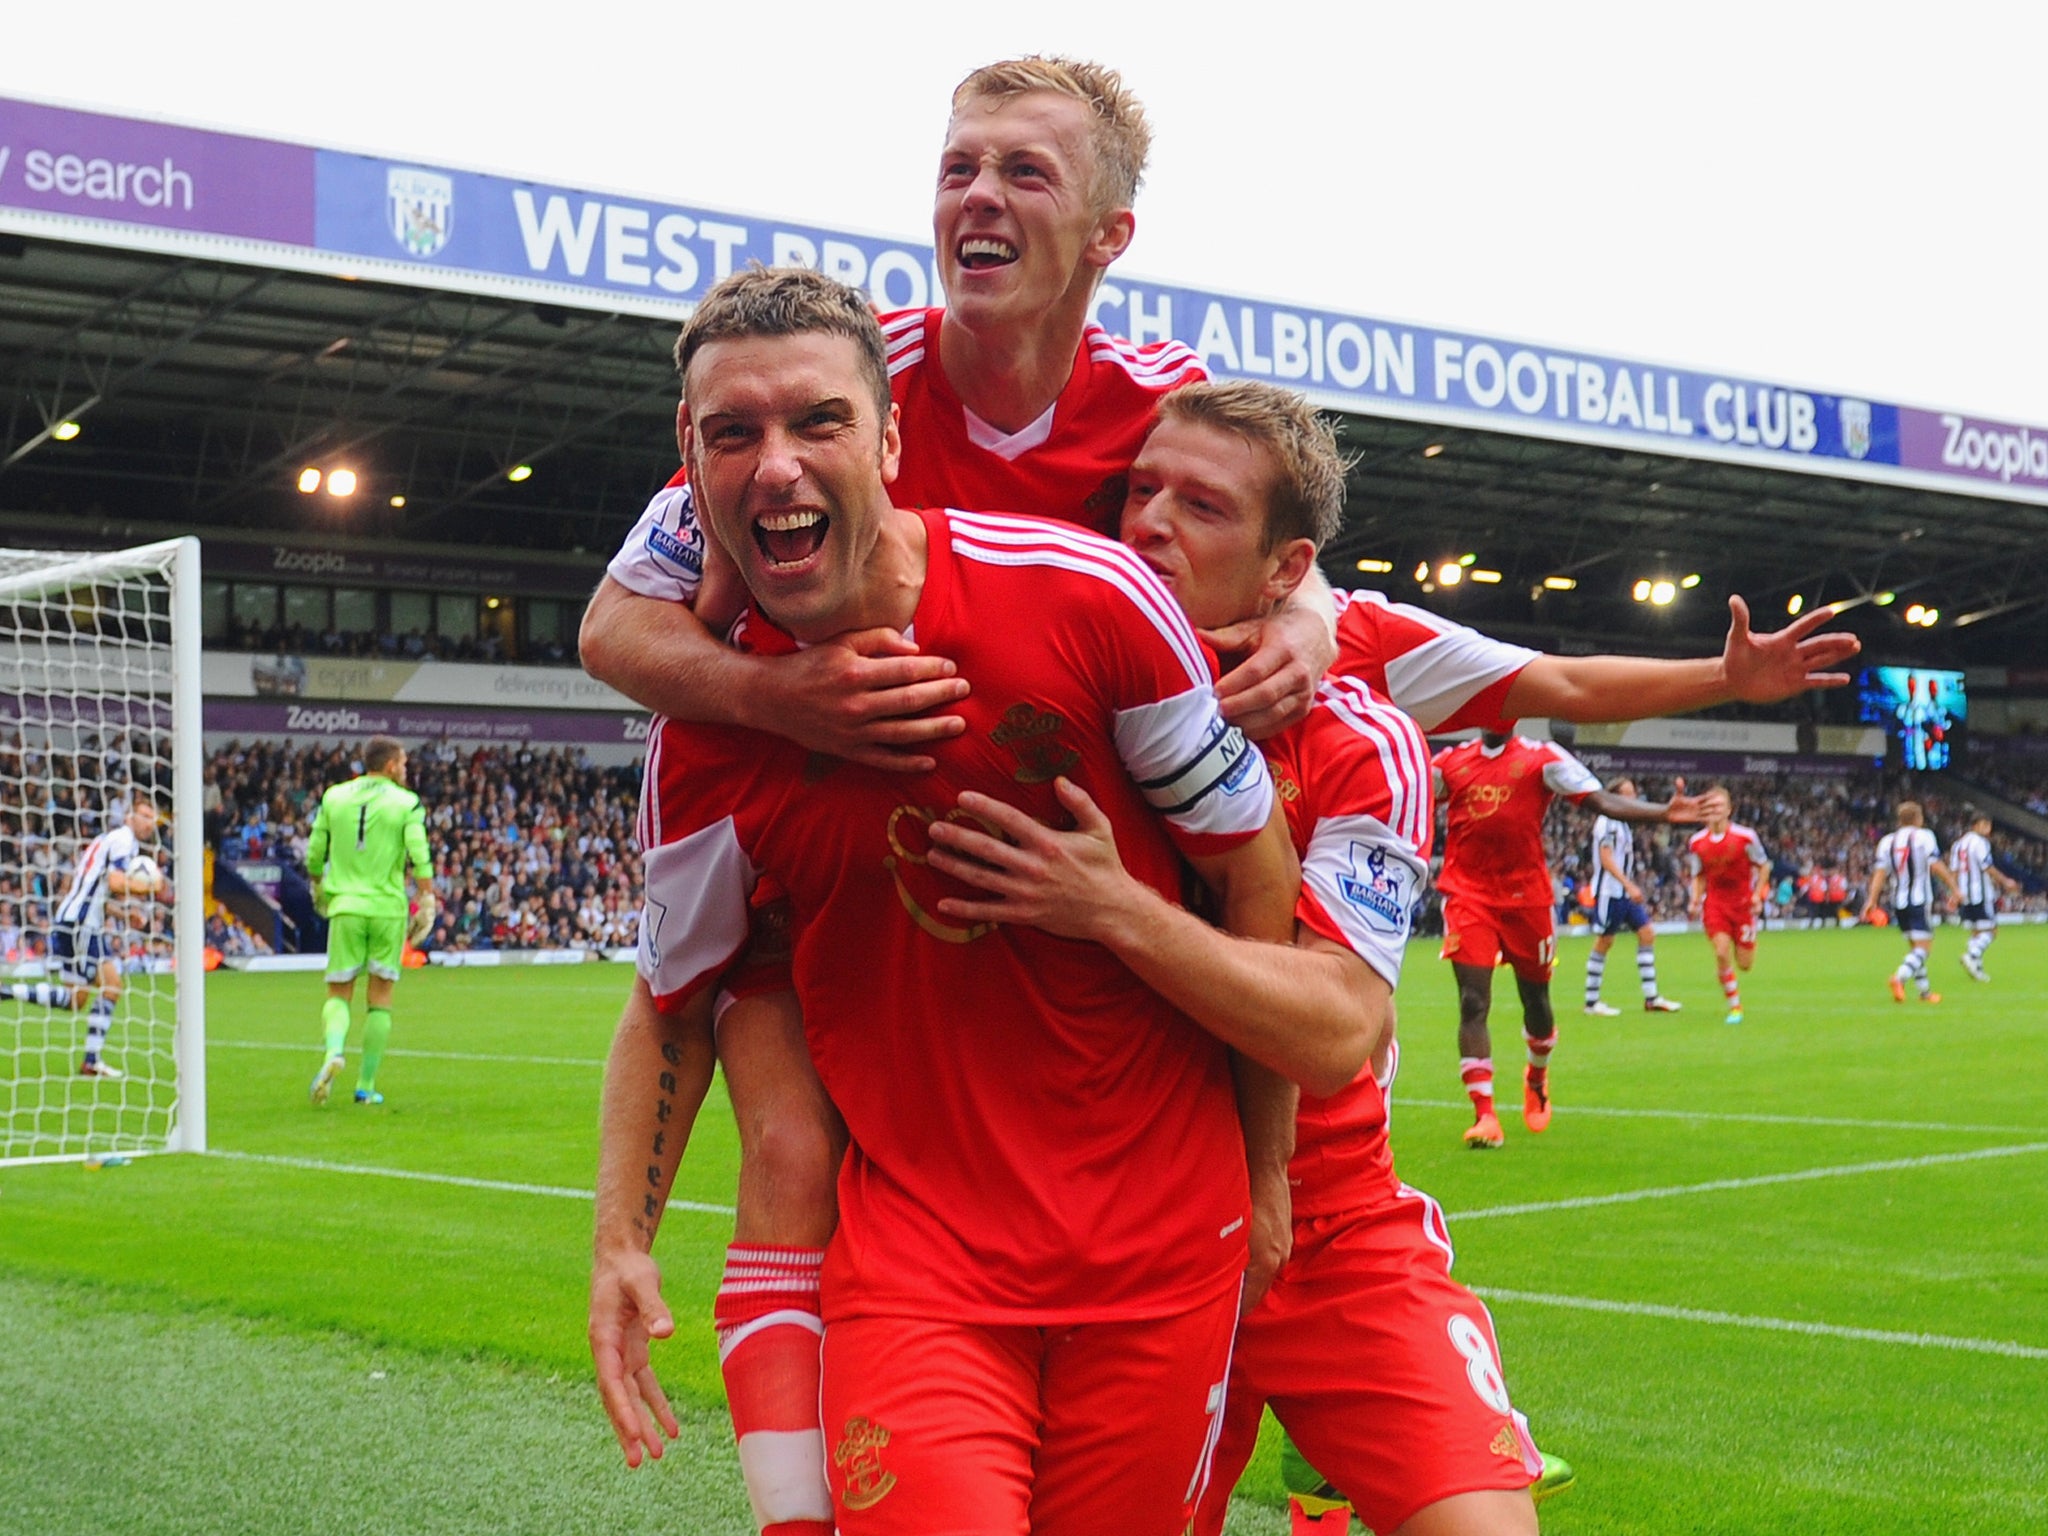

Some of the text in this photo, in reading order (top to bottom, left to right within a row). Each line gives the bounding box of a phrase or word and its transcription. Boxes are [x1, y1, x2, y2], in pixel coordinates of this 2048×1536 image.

[25, 149, 194, 211] search
[512, 189, 1818, 454] WEST BROCH ALBION FOOTBALL CLUB
[1940, 414, 2048, 484] Zoopla
[652, 530, 701, 564] BARCLAYS
[1893, 846, 1910, 874] 7
[1446, 1313, 1512, 1417] 8
